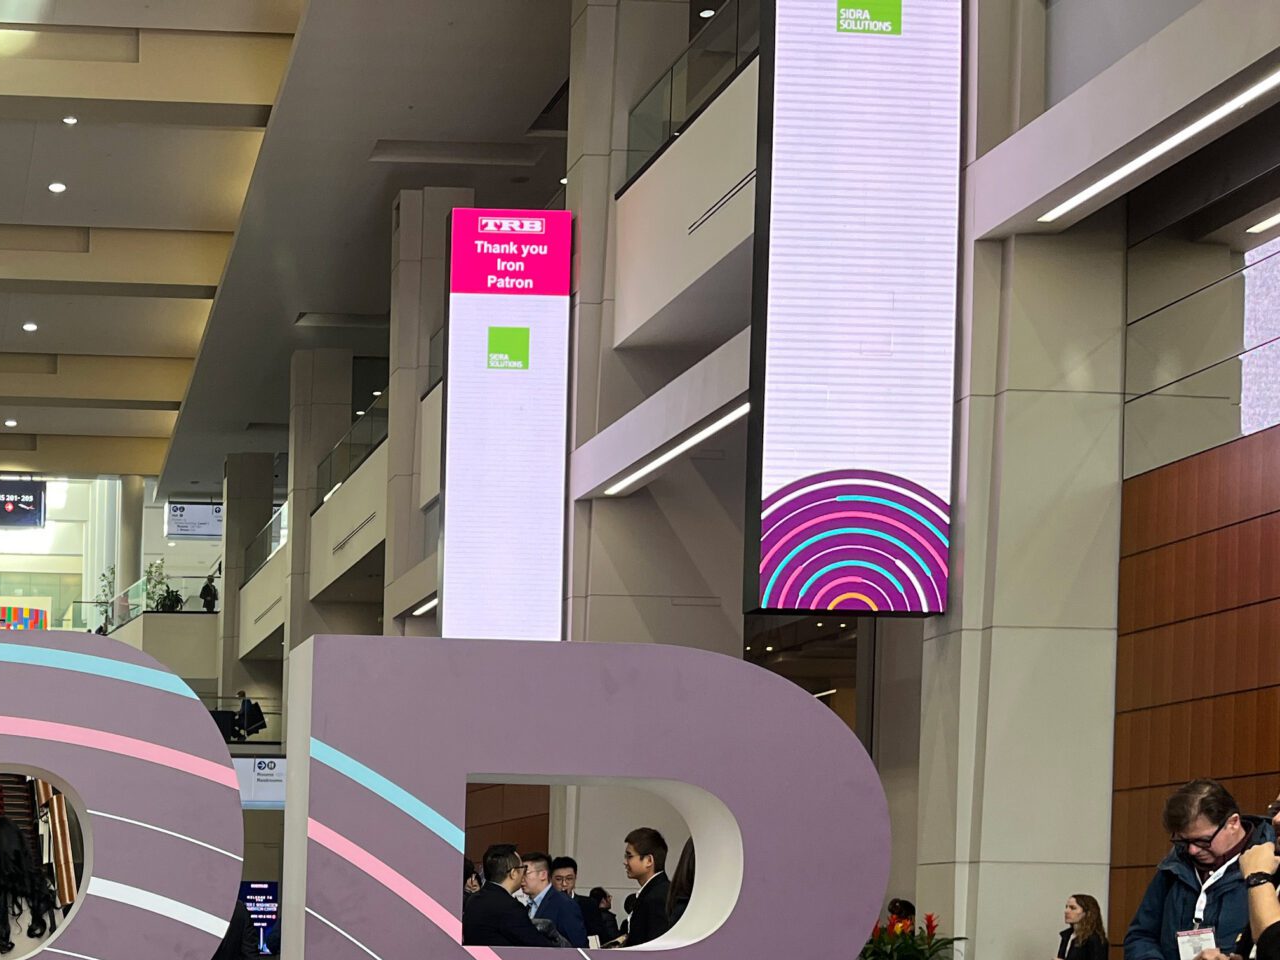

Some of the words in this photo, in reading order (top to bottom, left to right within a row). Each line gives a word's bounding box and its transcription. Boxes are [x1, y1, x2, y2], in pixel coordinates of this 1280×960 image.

[839, 8, 870, 19] SIDRA
[839, 20, 892, 32] SOLUTIONS
[480, 218, 543, 232] TRB
[474, 240, 518, 255] Thank
[521, 243, 548, 257] you
[496, 258, 525, 271] Iron
[487, 275, 534, 289] Patron
